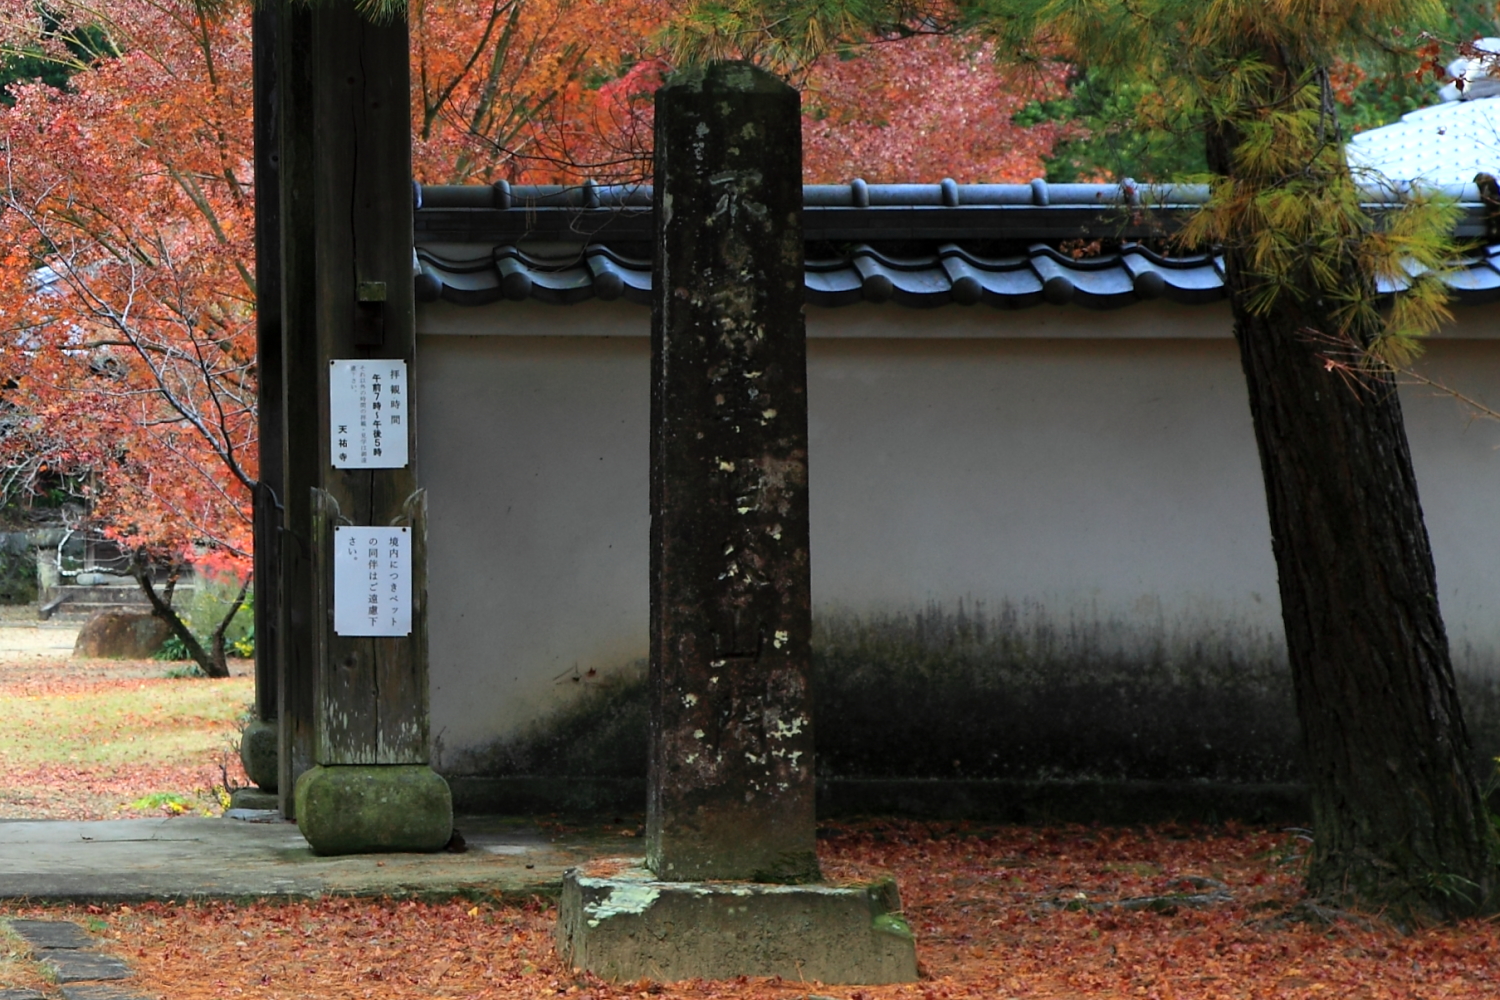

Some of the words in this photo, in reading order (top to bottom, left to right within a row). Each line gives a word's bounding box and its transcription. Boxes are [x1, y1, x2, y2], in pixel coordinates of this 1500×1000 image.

[390, 369, 401, 425] 拝観時間
[338, 425, 348, 462] 天祐寺
[348, 536, 357, 560] さい。
[368, 538, 378, 627] の同伴はご遠慮下
[389, 537, 399, 626] 境内につきペット
